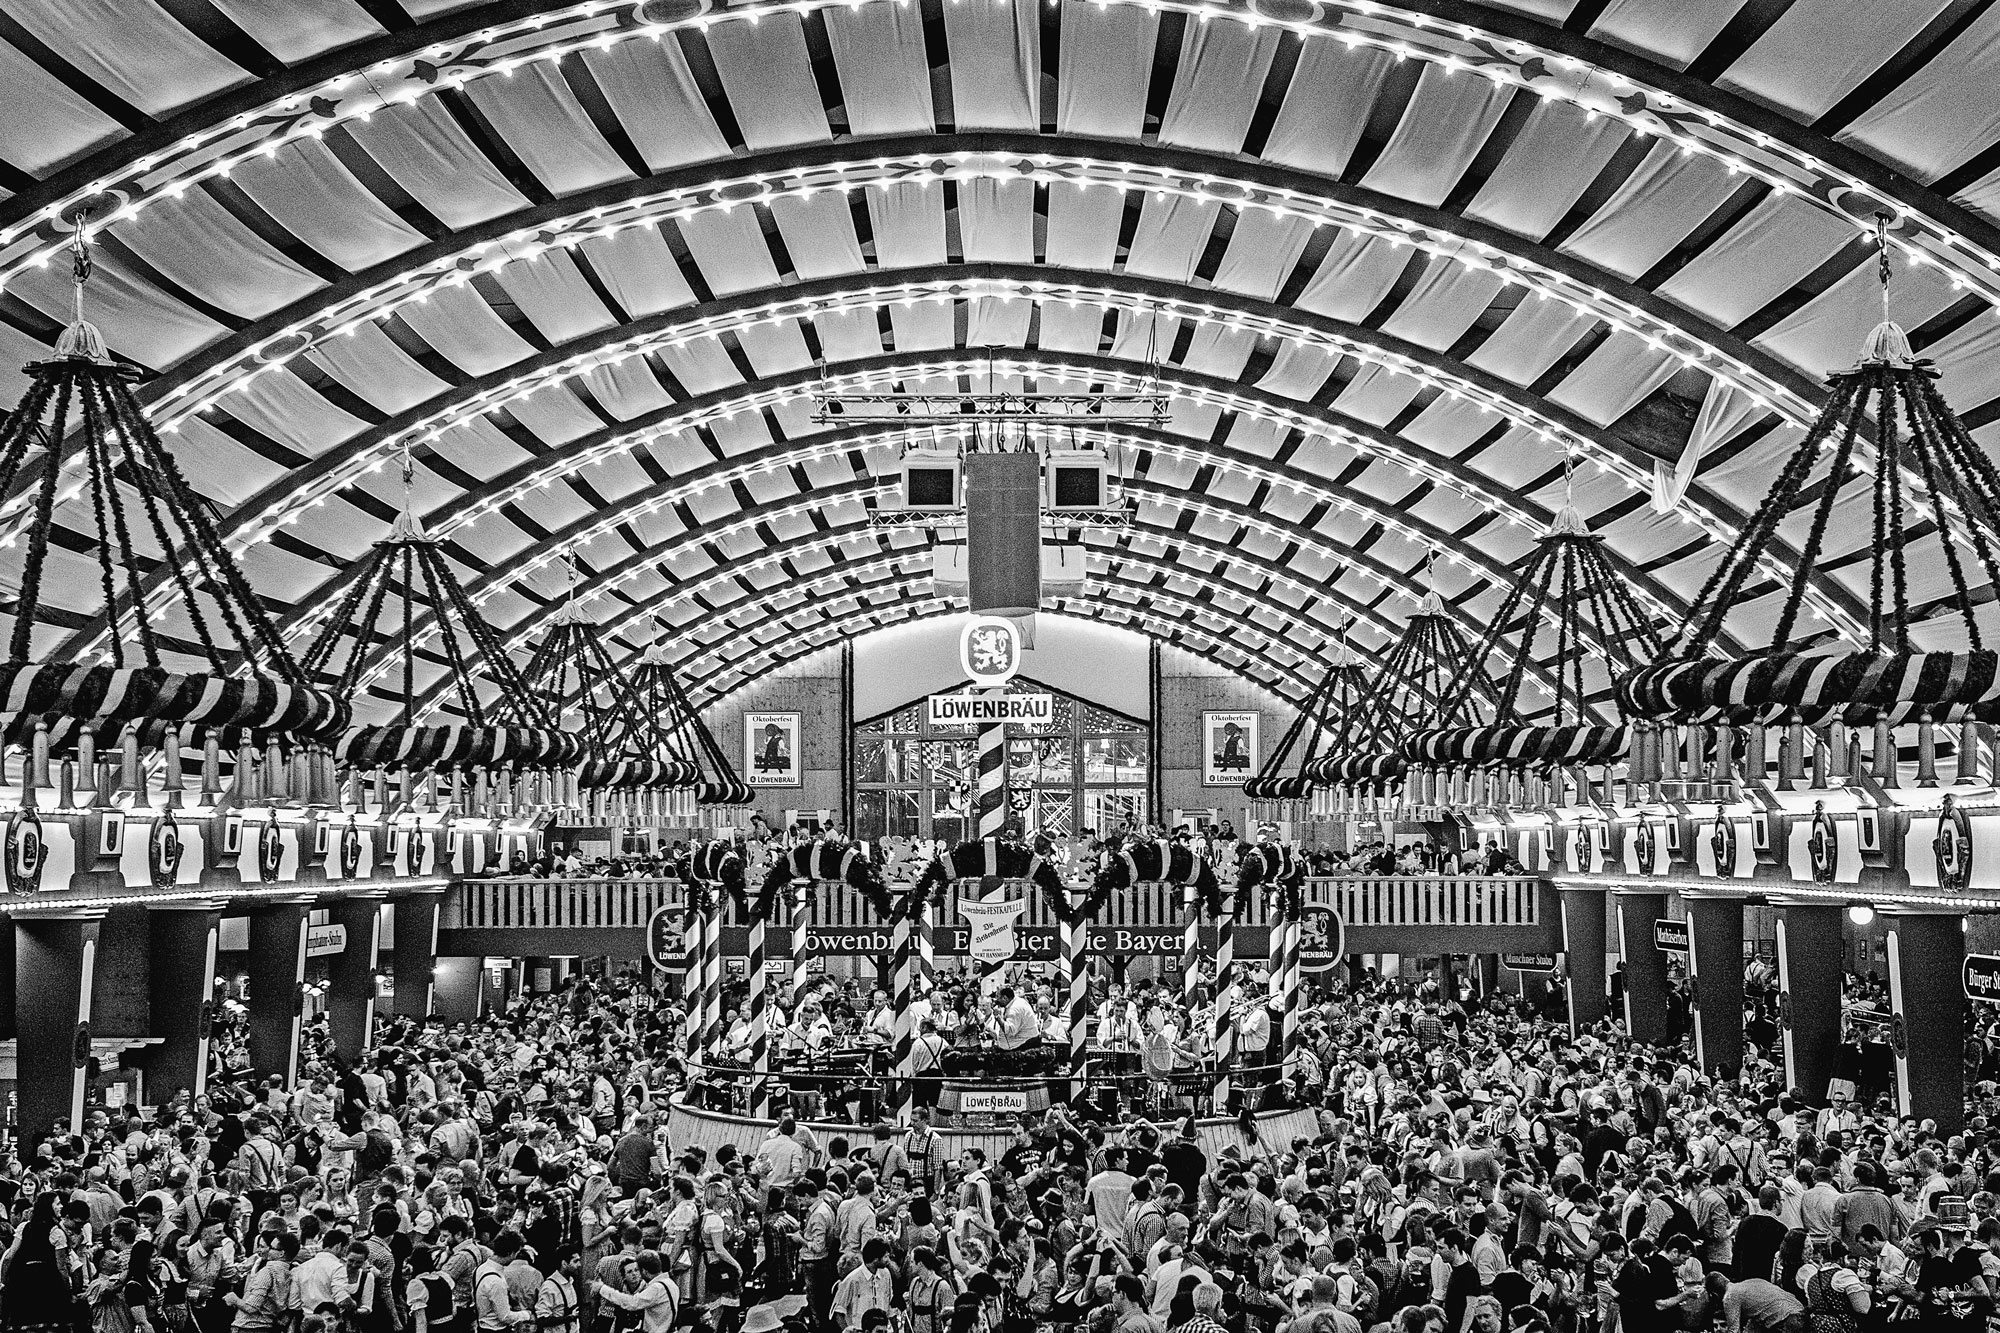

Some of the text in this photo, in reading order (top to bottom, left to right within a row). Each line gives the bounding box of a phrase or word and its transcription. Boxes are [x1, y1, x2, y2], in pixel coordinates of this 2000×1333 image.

[933, 697, 1048, 719] LÖWENBRÄU
[1085, 930, 1107, 951] ie
[1968, 967, 1992, 994] Bürger
